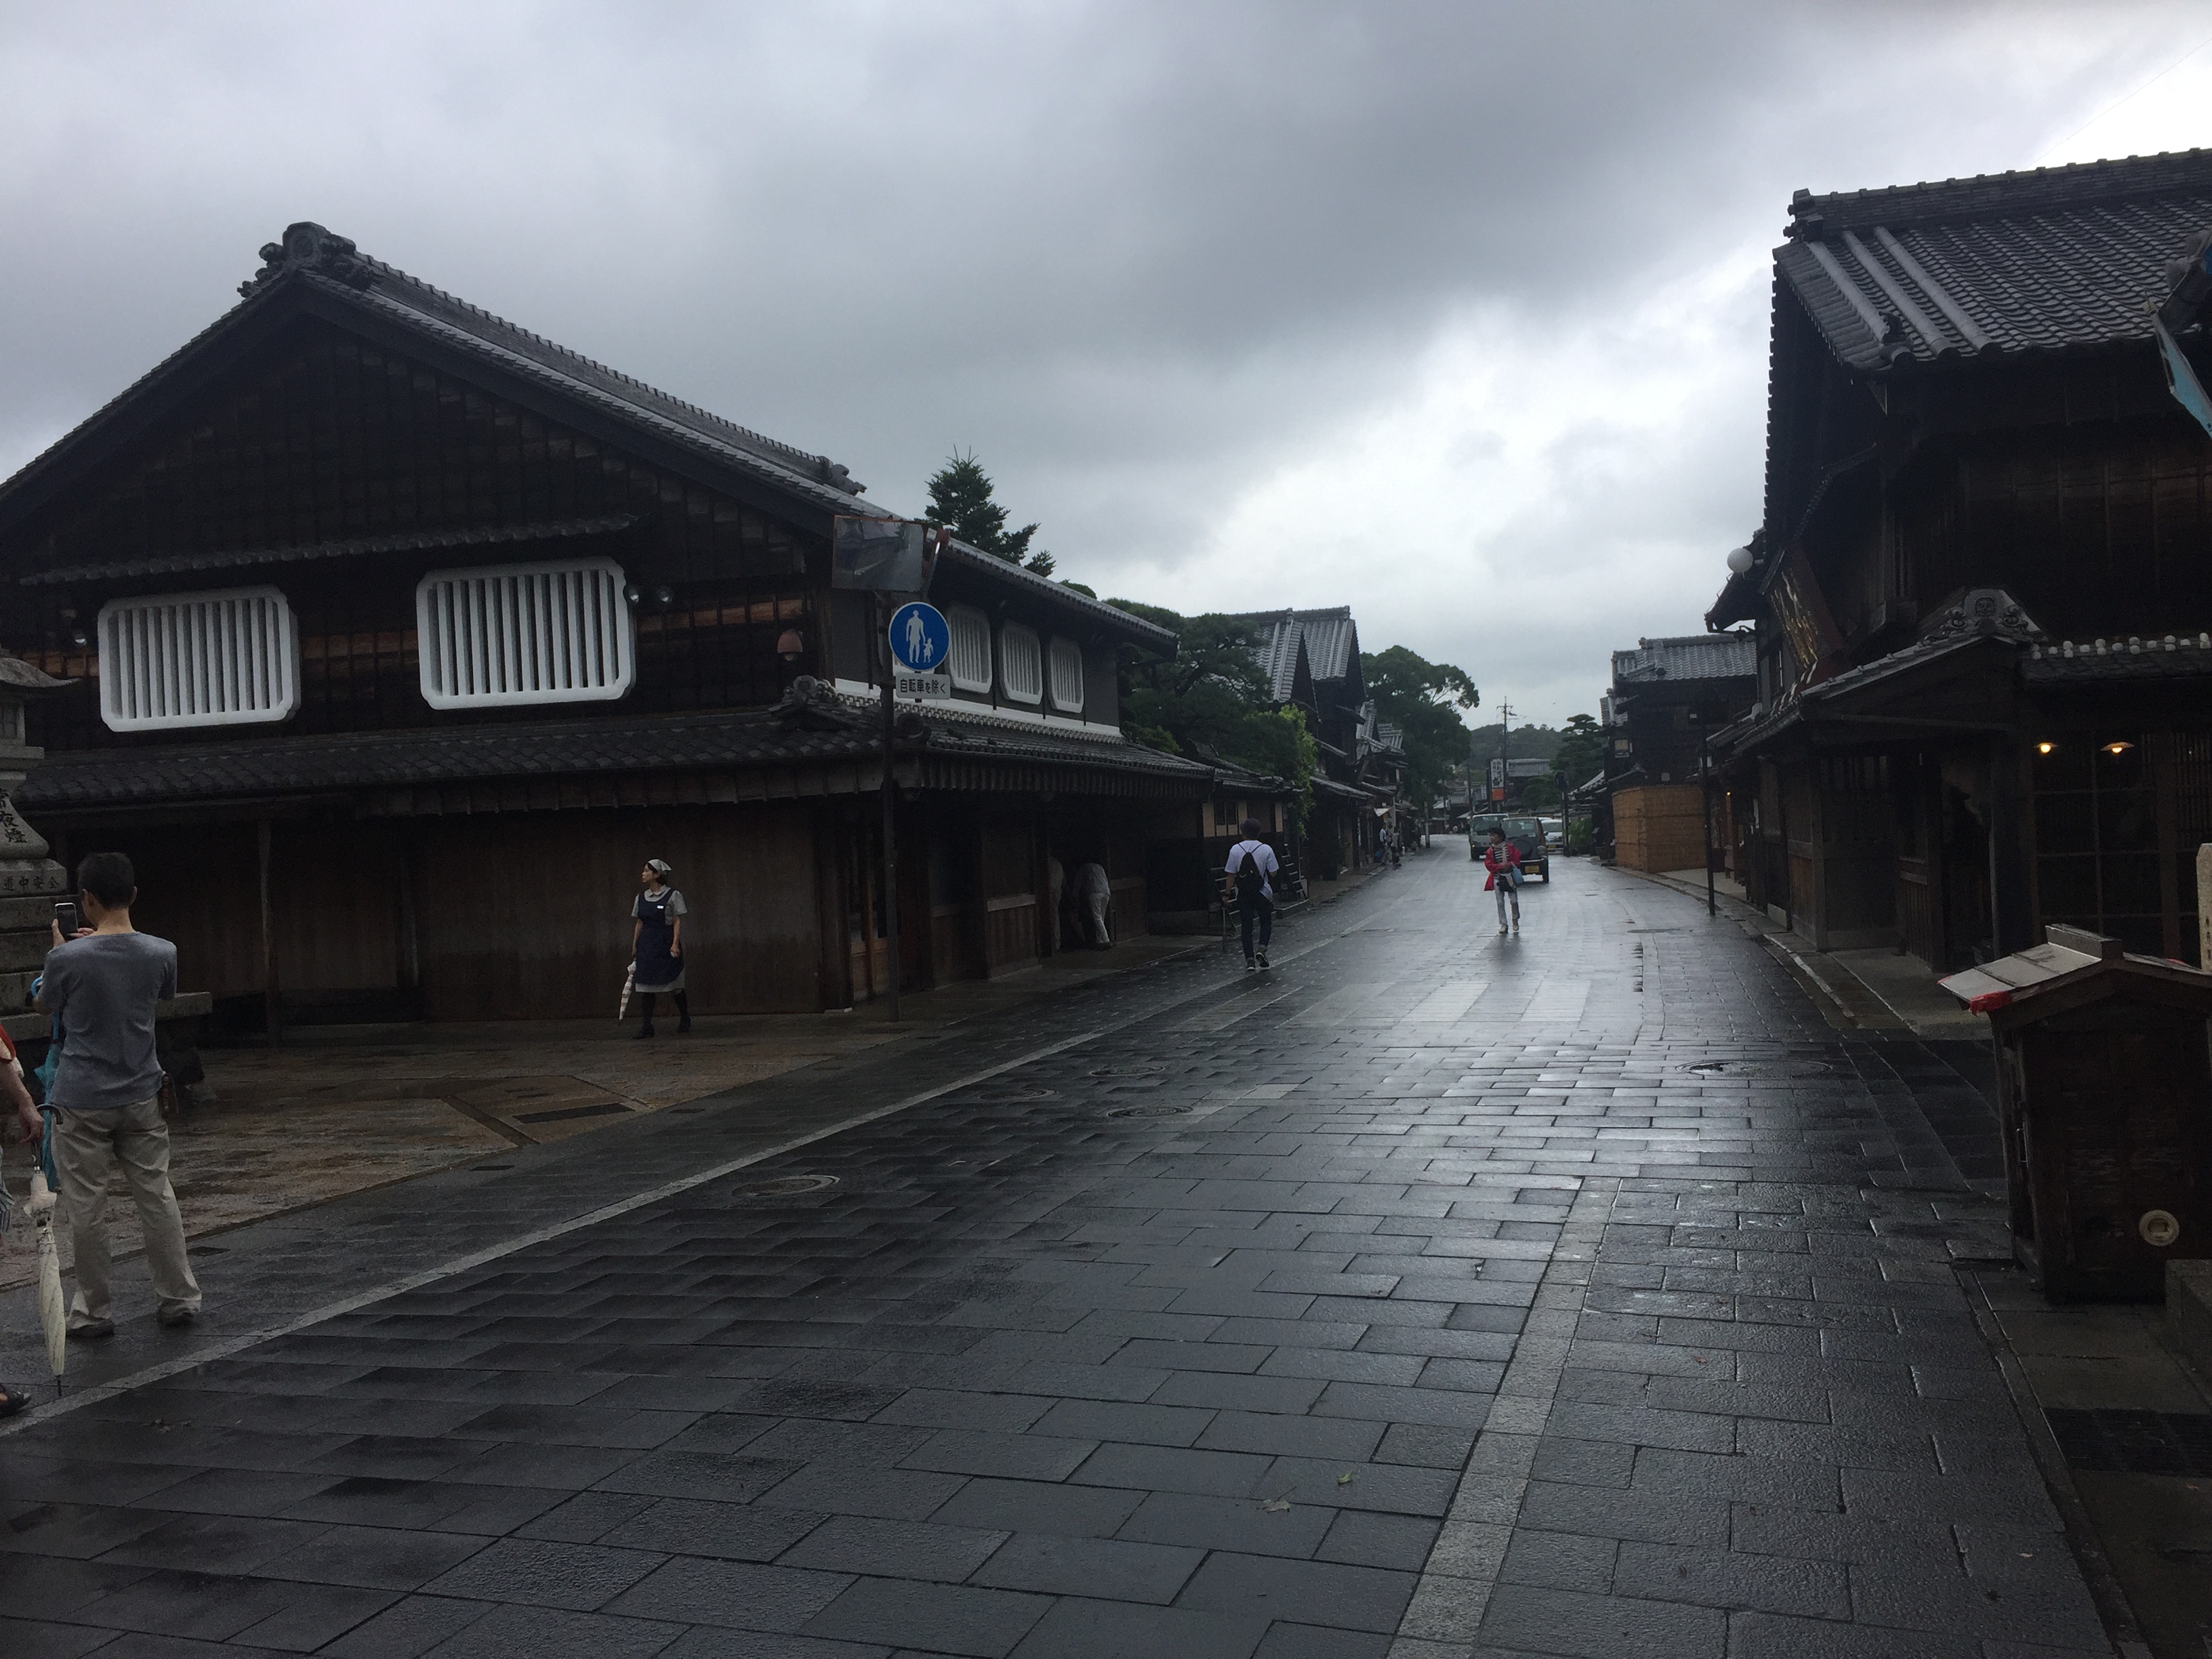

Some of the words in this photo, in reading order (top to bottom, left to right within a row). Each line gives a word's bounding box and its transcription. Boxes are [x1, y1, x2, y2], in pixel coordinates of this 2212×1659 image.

[900, 678, 946, 694] 自転車を除く
[3, 875, 59, 891] 道中安全
